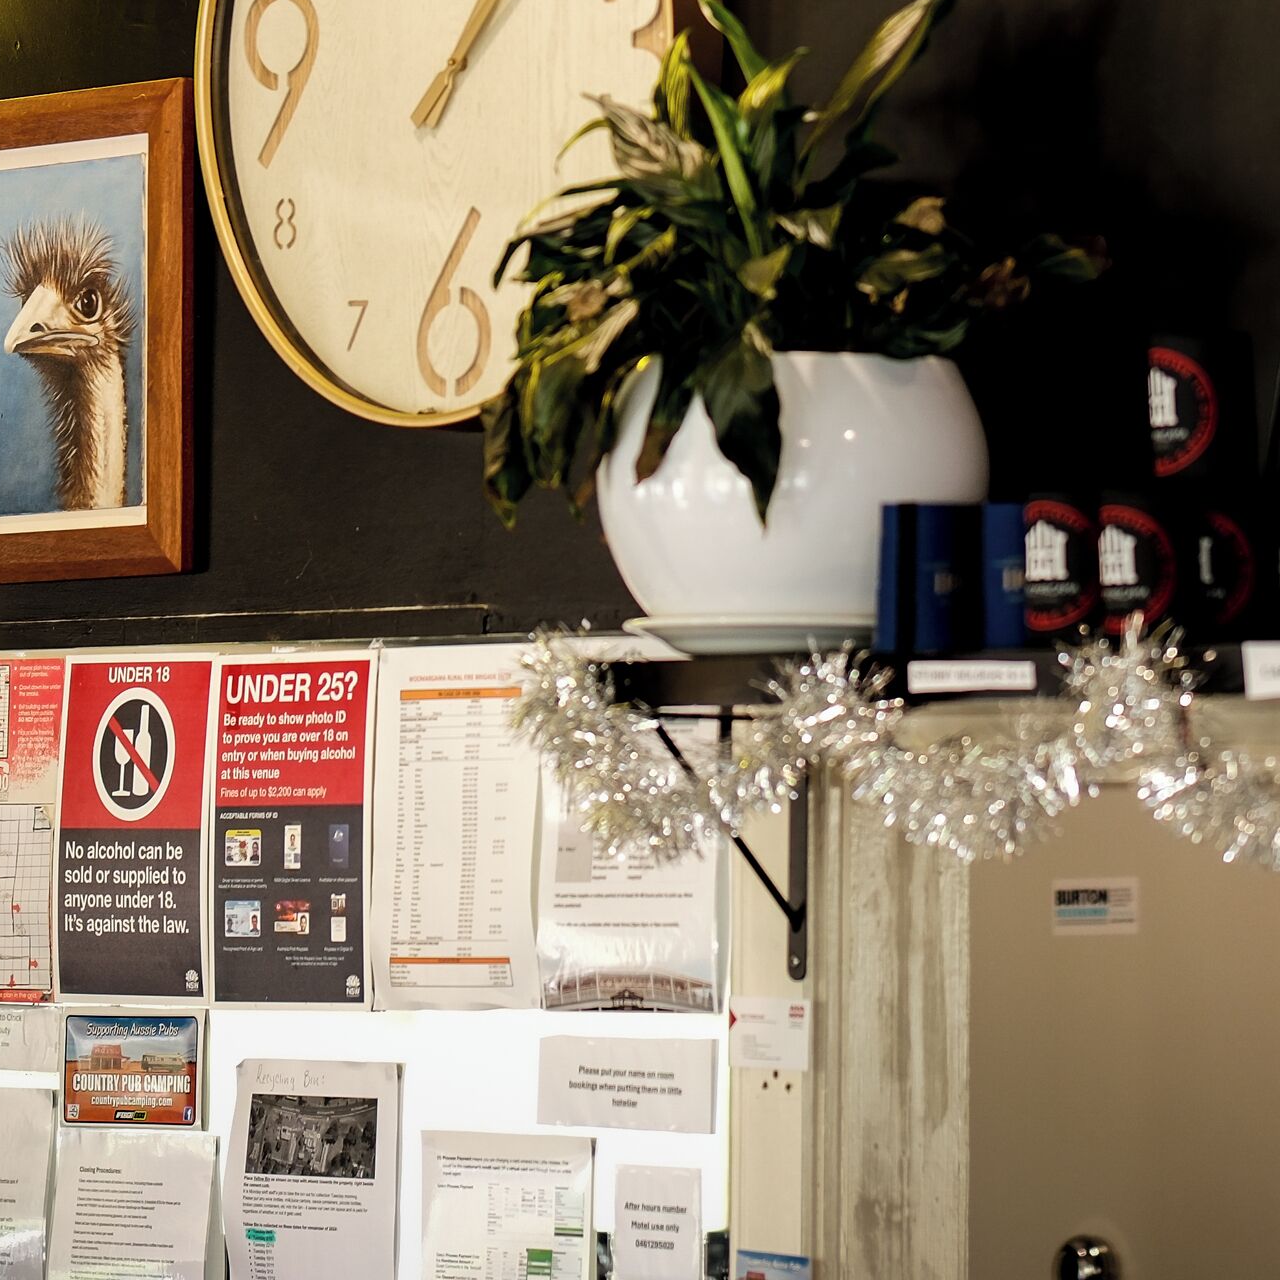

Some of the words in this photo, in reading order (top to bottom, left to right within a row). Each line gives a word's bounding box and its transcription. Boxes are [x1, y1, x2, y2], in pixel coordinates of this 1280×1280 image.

[274, 198, 297, 251] 8
[417, 207, 491, 397] 6
[347, 300, 369, 351] 7
[108, 667, 152, 683] UNDER
[155, 666, 170, 681] 18
[226, 673, 311, 704] UNDER
[316, 671, 358, 701] 25?
[224, 713, 236, 726] Be
[238, 713, 265, 728] ready
[267, 713, 276, 725] to
[278, 711, 304, 725] show
[306, 711, 333, 726] photo
[335, 710, 346, 723] ID
[223, 732, 232, 744] to
[234, 733, 260, 746] prove
[263, 733, 280, 745] you
[282, 732, 297, 742] are
[299, 731, 320, 742] over
[322, 729, 334, 741] 18
[336, 730, 348, 741] on
[222, 750, 245, 764] entry
[247, 751, 258, 761] or
[260, 748, 285, 761] when
[287, 747, 319, 762] buying
[321, 746, 355, 759] alcohol
[221, 769, 231, 780] at
[233, 767, 250, 779] this
[252, 768, 280, 779] venue
[220, 787, 238, 798] Fines
[240, 787, 248, 797] of
[249, 788, 258, 799] up
[259, 787, 267, 797] to
[268, 786, 291, 798] $2,200
[292, 787, 306, 796] can
[307, 786, 326, 799] apply
[65, 841, 84, 859] No
[87, 841, 135, 859] alcohol
[138, 845, 162, 859] can
[166, 842, 183, 860] be
[64, 866, 92, 883] sold
[96, 870, 110, 884] or
[113, 866, 169, 888] supplied
[172, 869, 186, 884] to
[64, 895, 112, 912] anyone
[115, 891, 154, 908] under
[158, 892, 176, 909] 18.
[1055, 888, 1108, 906] BURTON
[64, 914, 83, 932] It's
[86, 915, 135, 937] against
[138, 915, 160, 933] the
[163, 915, 190, 934] law.
[87, 1022, 128, 1039] Supporting
[130, 1022, 156, 1036] Aussie
[159, 1022, 179, 1036] Pubs
[256, 1064, 295, 1091] Recycling
[579, 1065, 599, 1076] Please
[600, 1067, 612, 1077] put
[628, 1070, 645, 1079] name
[646, 1071, 656, 1079] on
[657, 1071, 674, 1080] room
[73, 1074, 120, 1092] COUNTRY
[122, 1075, 141, 1092] PUB
[144, 1075, 191, 1093] CAMPING
[569, 1080, 597, 1091] bookings
[599, 1082, 616, 1091] when
[617, 1084, 640, 1094] putting
[641, 1084, 658, 1094] them
[660, 1085, 666, 1093] in
[91, 1095, 173, 1108] countrypubcamping.com
[612, 1098, 638, 1108] hotelier
[80, 1166, 96, 1174] Closing
[624, 1201, 640, 1210] After
[641, 1203, 661, 1213] hours
[662, 1205, 687, 1214] number
[631, 1220, 650, 1230] Motel
[651, 1223, 664, 1231] use
[665, 1223, 680, 1233] only
